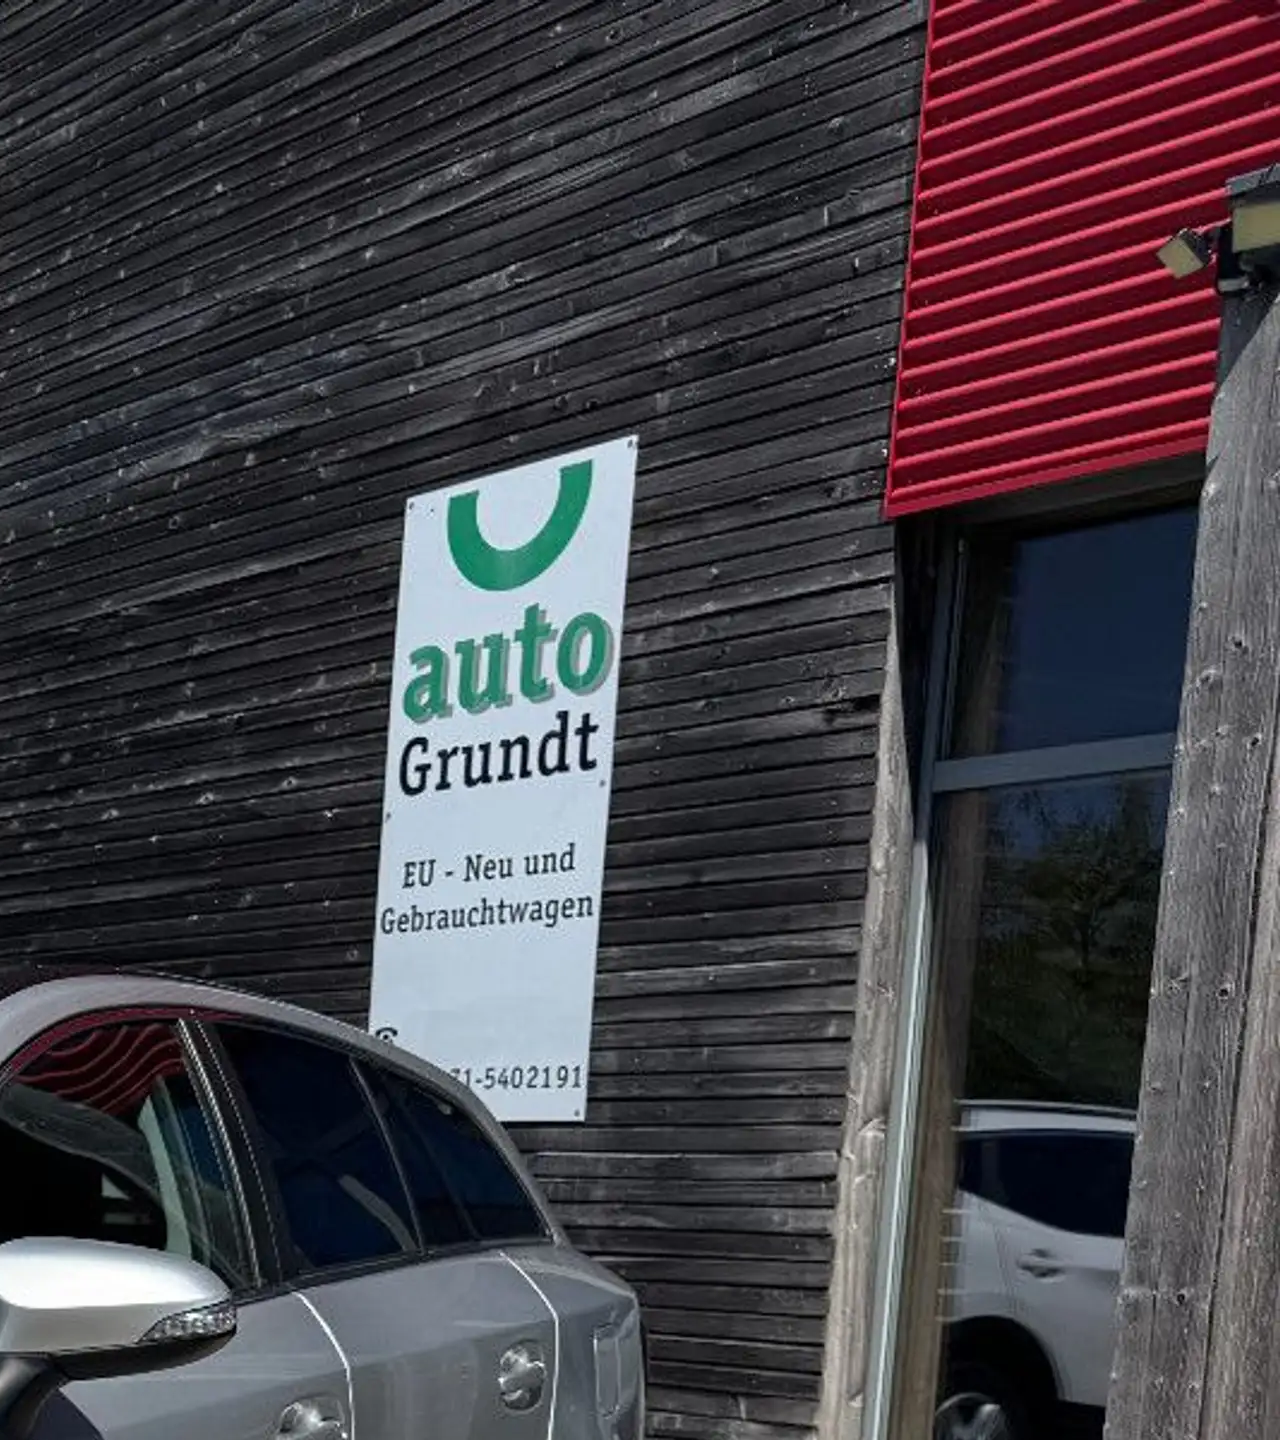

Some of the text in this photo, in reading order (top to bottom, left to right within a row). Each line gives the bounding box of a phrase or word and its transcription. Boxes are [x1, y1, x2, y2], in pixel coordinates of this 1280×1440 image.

[403, 602, 614, 724] auto
[399, 710, 599, 796] Grundt
[402, 859, 436, 889] EU
[463, 854, 513, 882] Neu
[524, 842, 576, 875] und
[380, 895, 593, 934] Gebrauchtwagen
